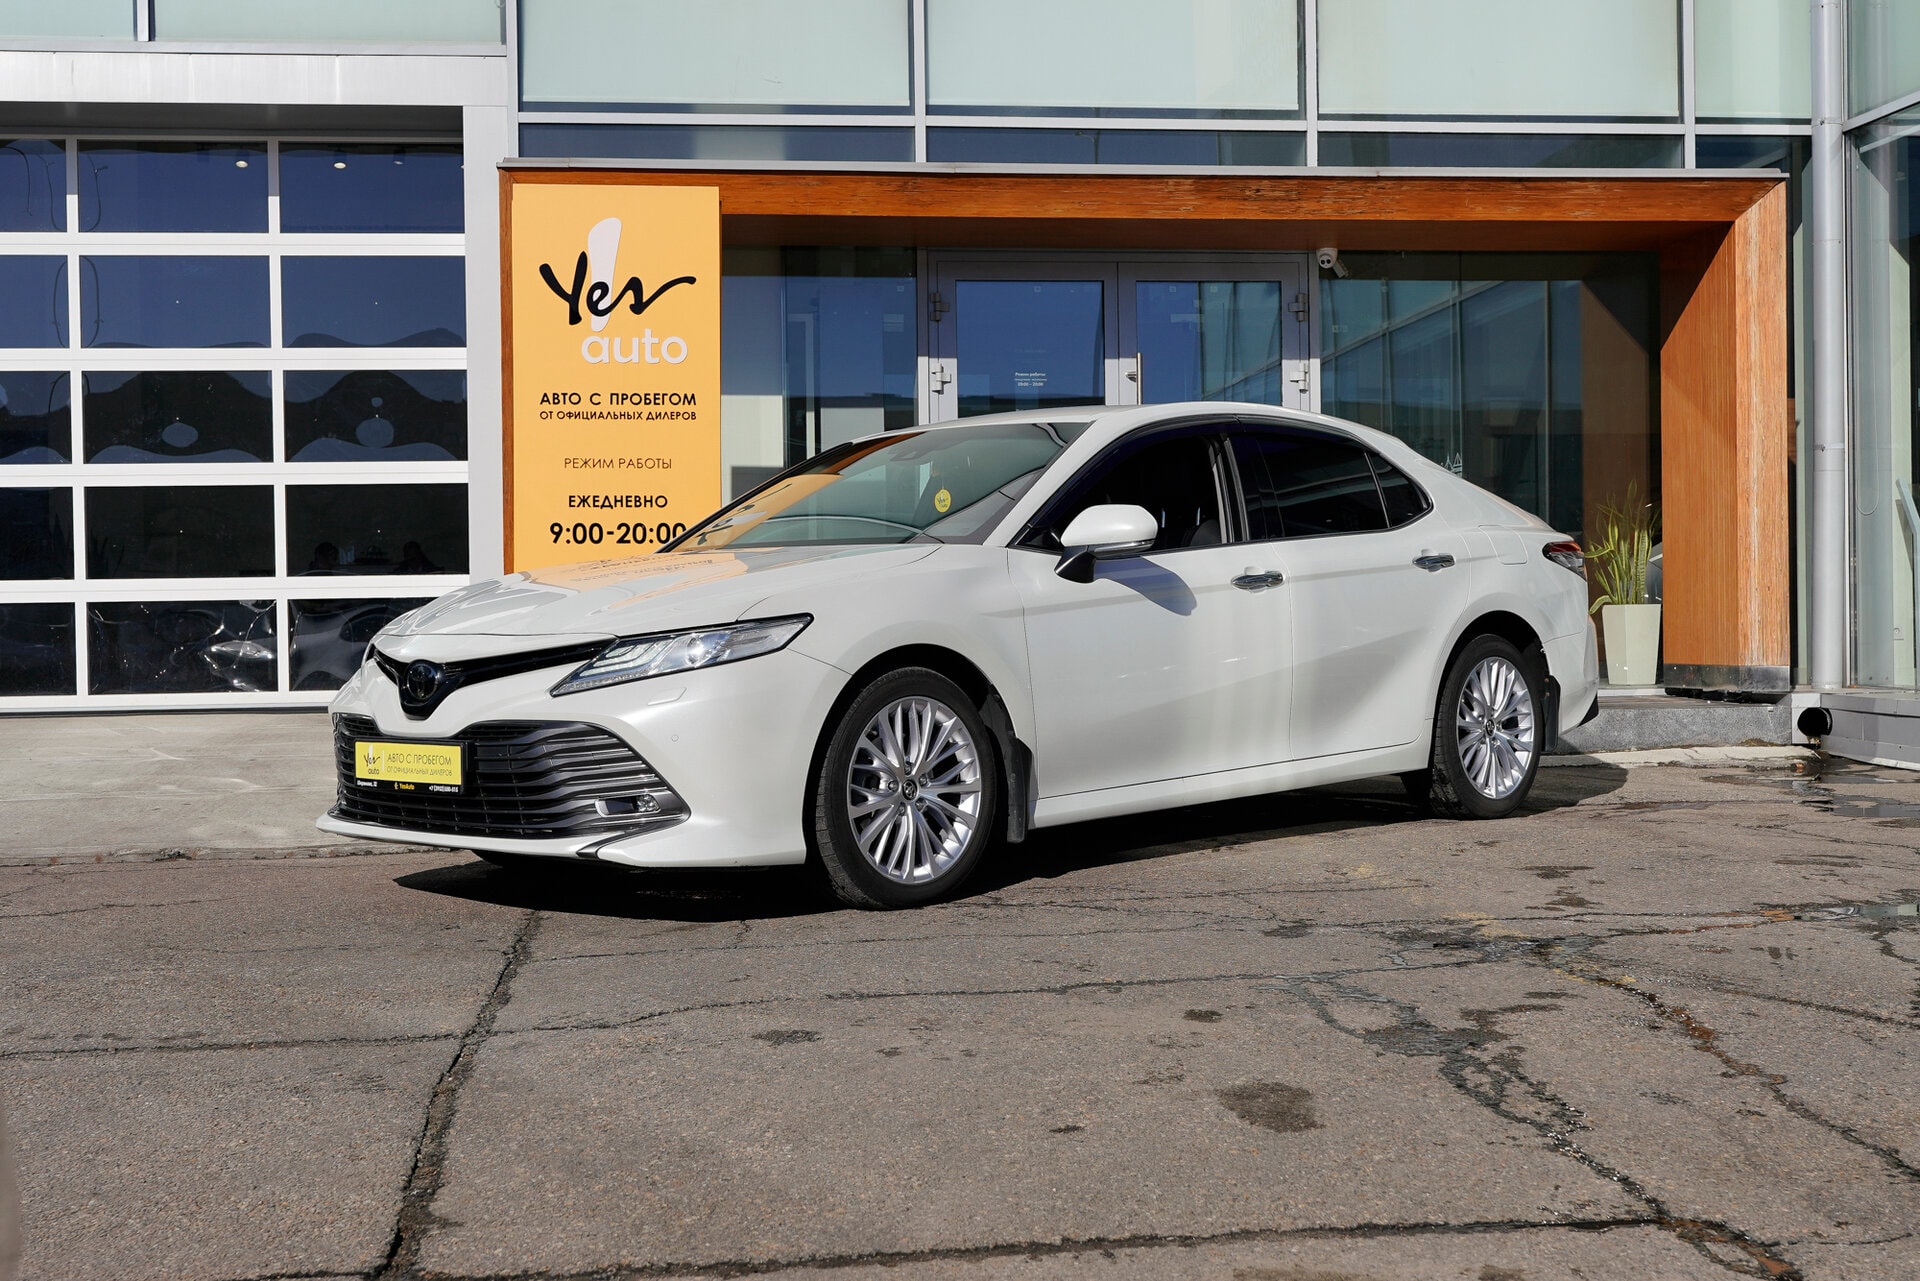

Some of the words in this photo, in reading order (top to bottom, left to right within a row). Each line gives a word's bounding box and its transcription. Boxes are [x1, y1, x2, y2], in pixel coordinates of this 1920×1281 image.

[539, 250, 697, 326] Yes
[581, 328, 689, 364] auto
[539, 392, 582, 406] АВТО
[589, 392, 602, 406] С
[609, 392, 697, 406] ПРОБЕГОМ
[539, 411, 554, 420] ОТ
[556, 411, 643, 421] ОФИЦИАЛЬНЫХ
[645, 411, 697, 421] ДИЛЕРОВ
[564, 457, 615, 469] РЕЖИМ
[618, 457, 673, 469] РАБОТЫ
[568, 495, 668, 510] ЕЖЕДНЕВНО
[387, 754, 405, 764] АВТО
[405, 754, 413, 764] С
[413, 754, 452, 766] ПРОБЕГОМ
[395, 766, 429, 775] ОФИЦИАЛЬНЫХ
[429, 768, 453, 777] ДИЛЕРОВ
